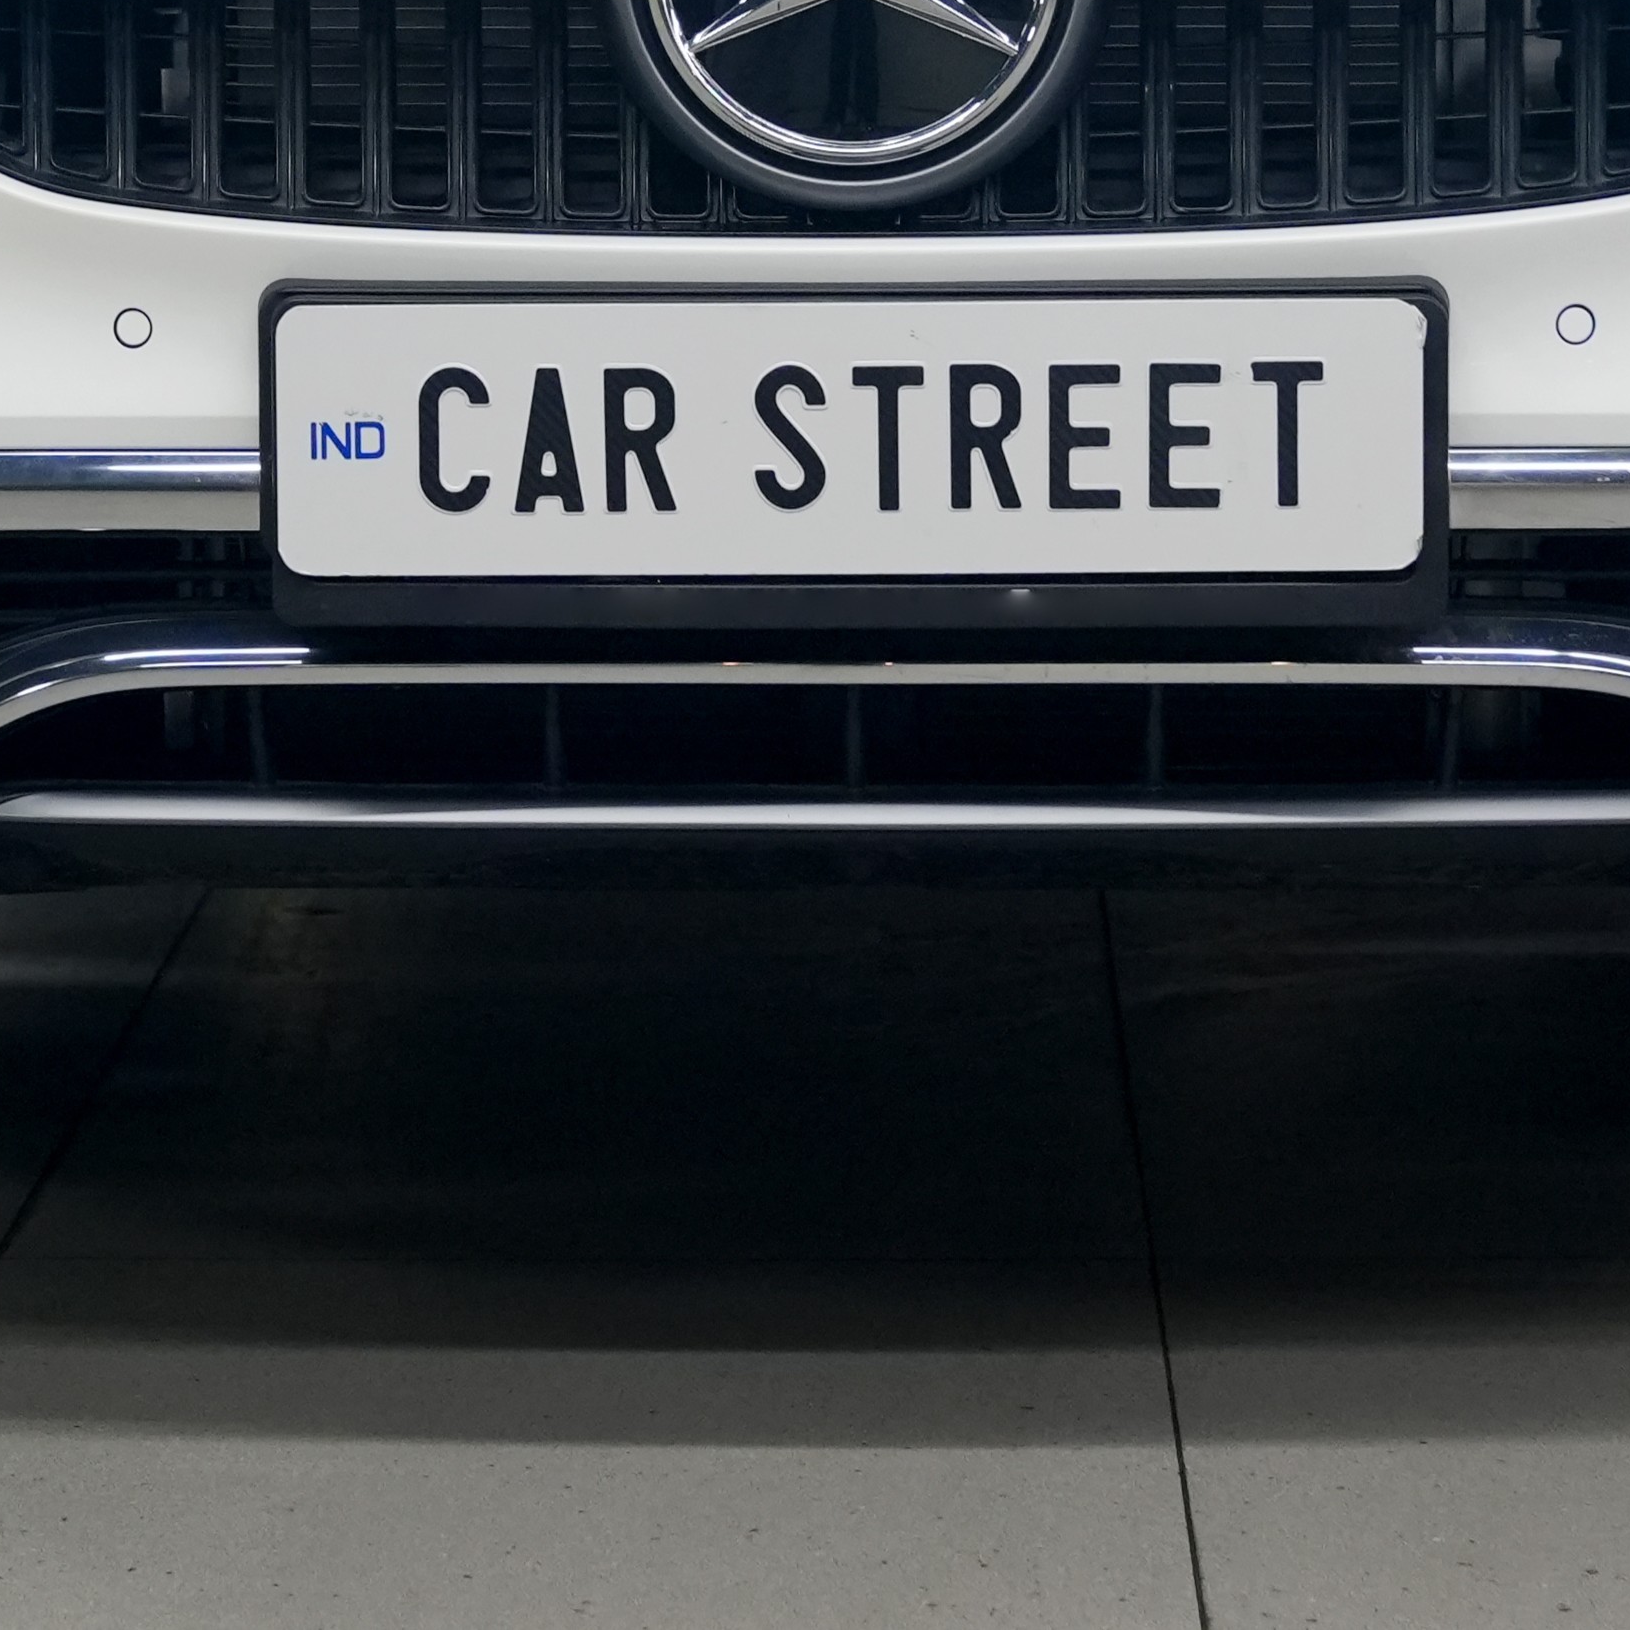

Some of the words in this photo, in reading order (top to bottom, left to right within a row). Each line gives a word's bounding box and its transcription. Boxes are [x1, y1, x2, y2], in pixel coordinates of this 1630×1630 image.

[310, 421, 386, 460] IND
[417, 365, 678, 514] CAR
[753, 360, 1325, 512] STREET
